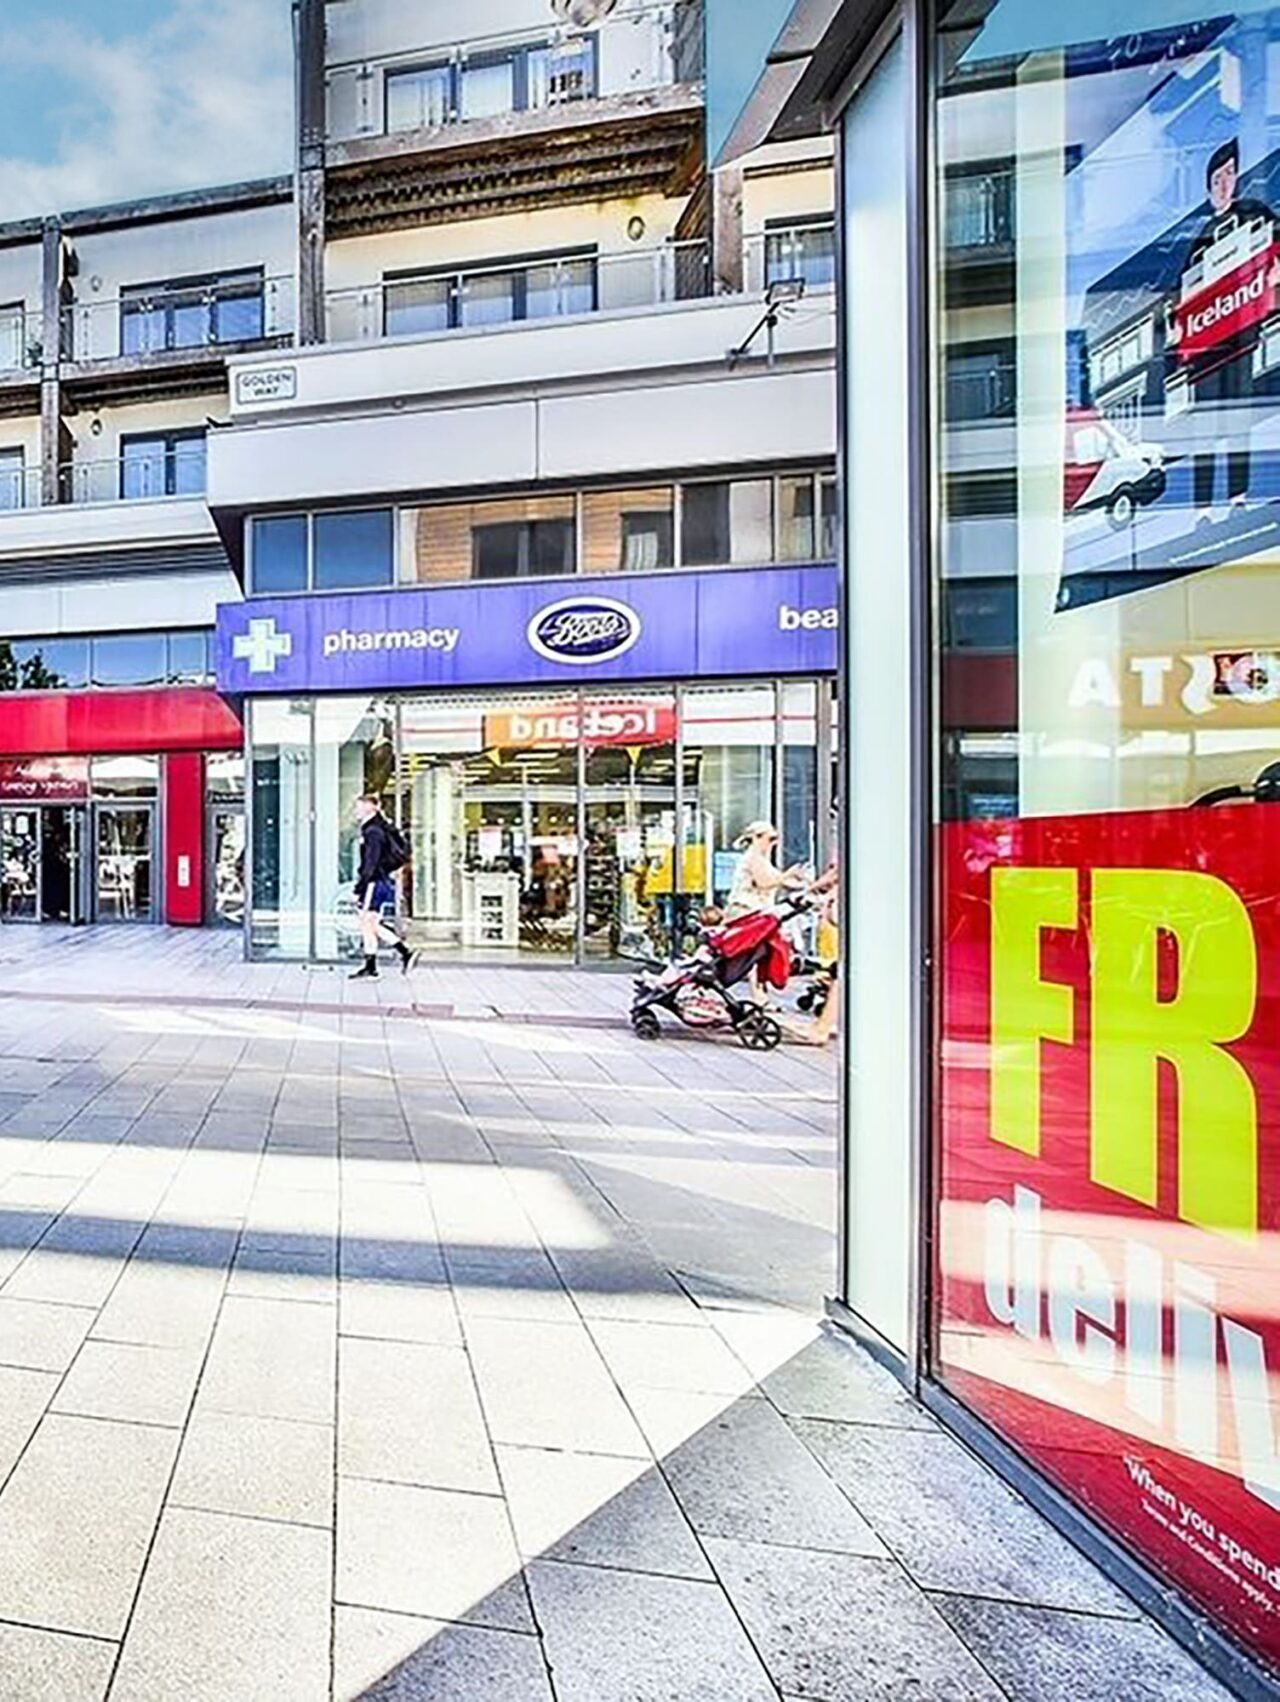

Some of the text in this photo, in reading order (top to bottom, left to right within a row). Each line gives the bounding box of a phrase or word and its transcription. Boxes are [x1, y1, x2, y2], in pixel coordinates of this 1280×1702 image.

[1185, 267, 1266, 338] Iceland
[241, 373, 292, 387] GOLDEN
[538, 611, 631, 647] Boots
[779, 604, 839, 631] bea
[323, 627, 461, 657] pharmacy
[988, 866, 1259, 1247] FR
[1178, 1502, 1216, 1541] you
